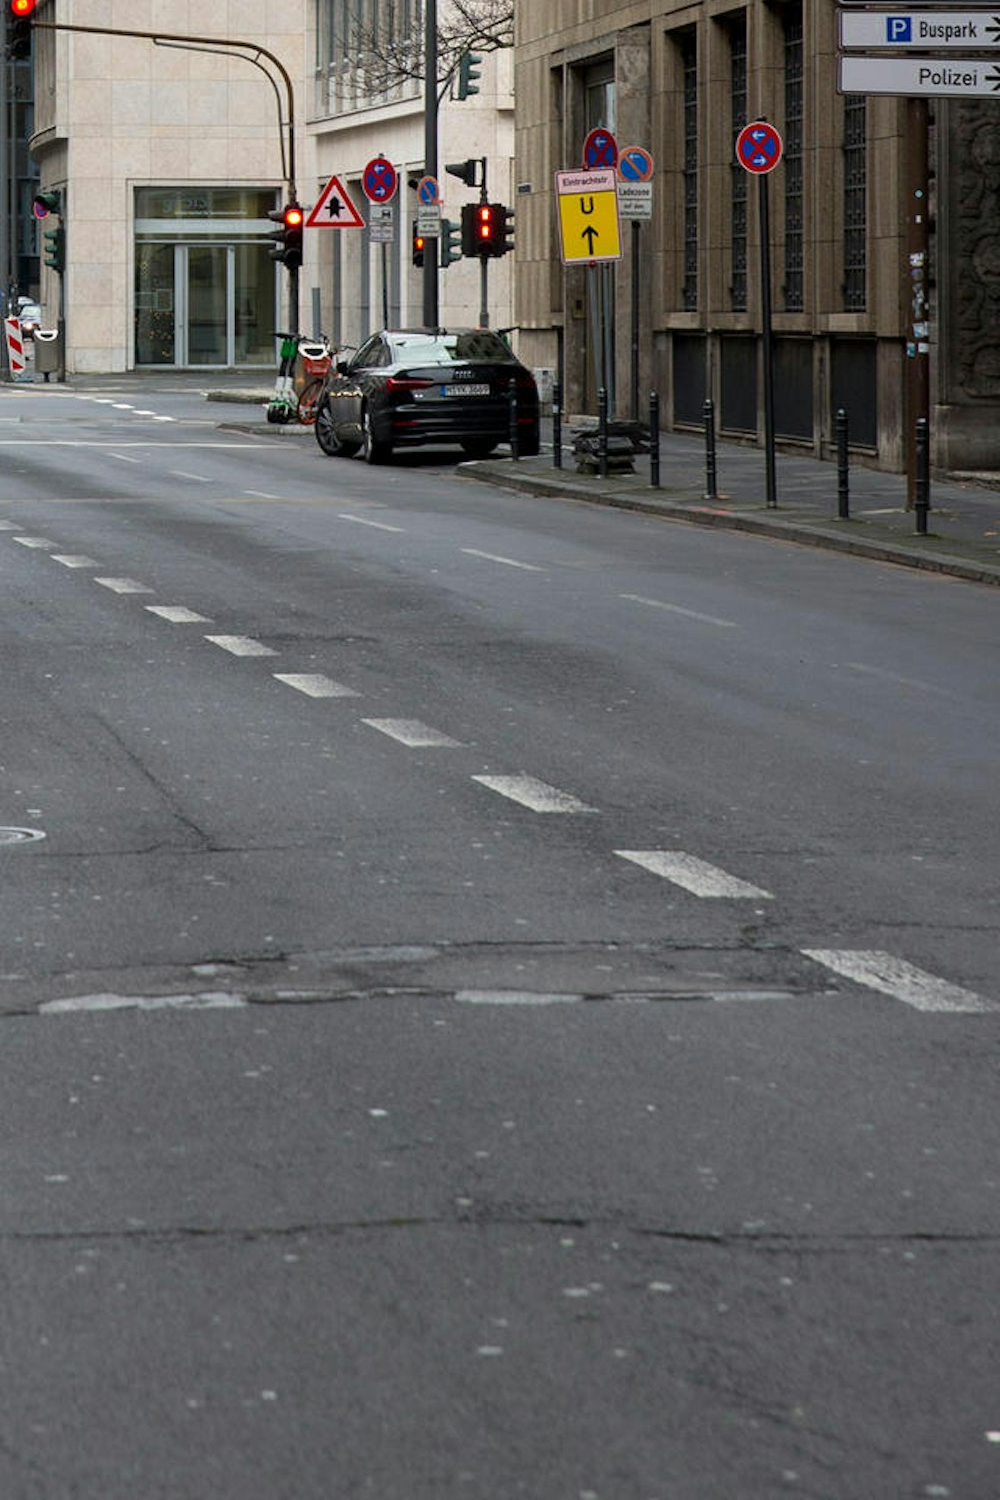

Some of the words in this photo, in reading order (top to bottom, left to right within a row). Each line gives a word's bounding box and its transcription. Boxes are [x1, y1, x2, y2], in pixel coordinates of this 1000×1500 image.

[891, 18, 907, 40] P
[919, 21, 977, 42] Buspark
[918, 68, 978, 87] Polizei
[580, 195, 594, 215] U
